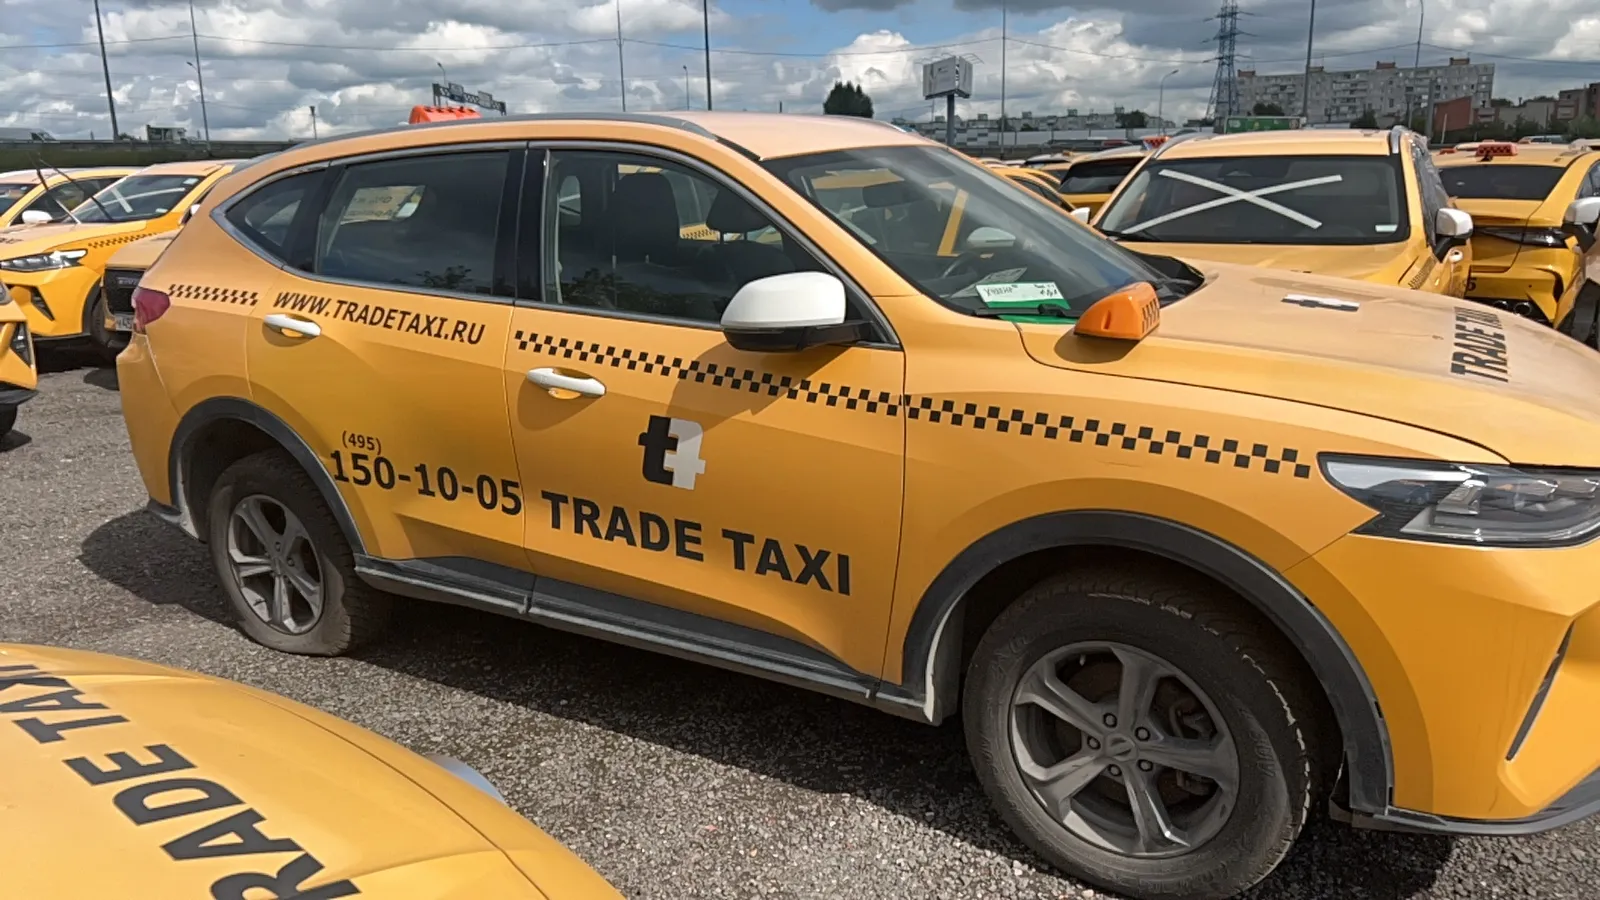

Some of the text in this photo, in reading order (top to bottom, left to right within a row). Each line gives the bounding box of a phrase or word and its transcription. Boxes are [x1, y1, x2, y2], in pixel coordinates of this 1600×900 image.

[273, 291, 486, 345] WWW.TRADETAXI.RU
[1450, 323, 1509, 383] TRADE
[342, 430, 382, 456] (495)
[330, 450, 522, 516] 150-10-05
[541, 490, 851, 597] TRADE TAXI
